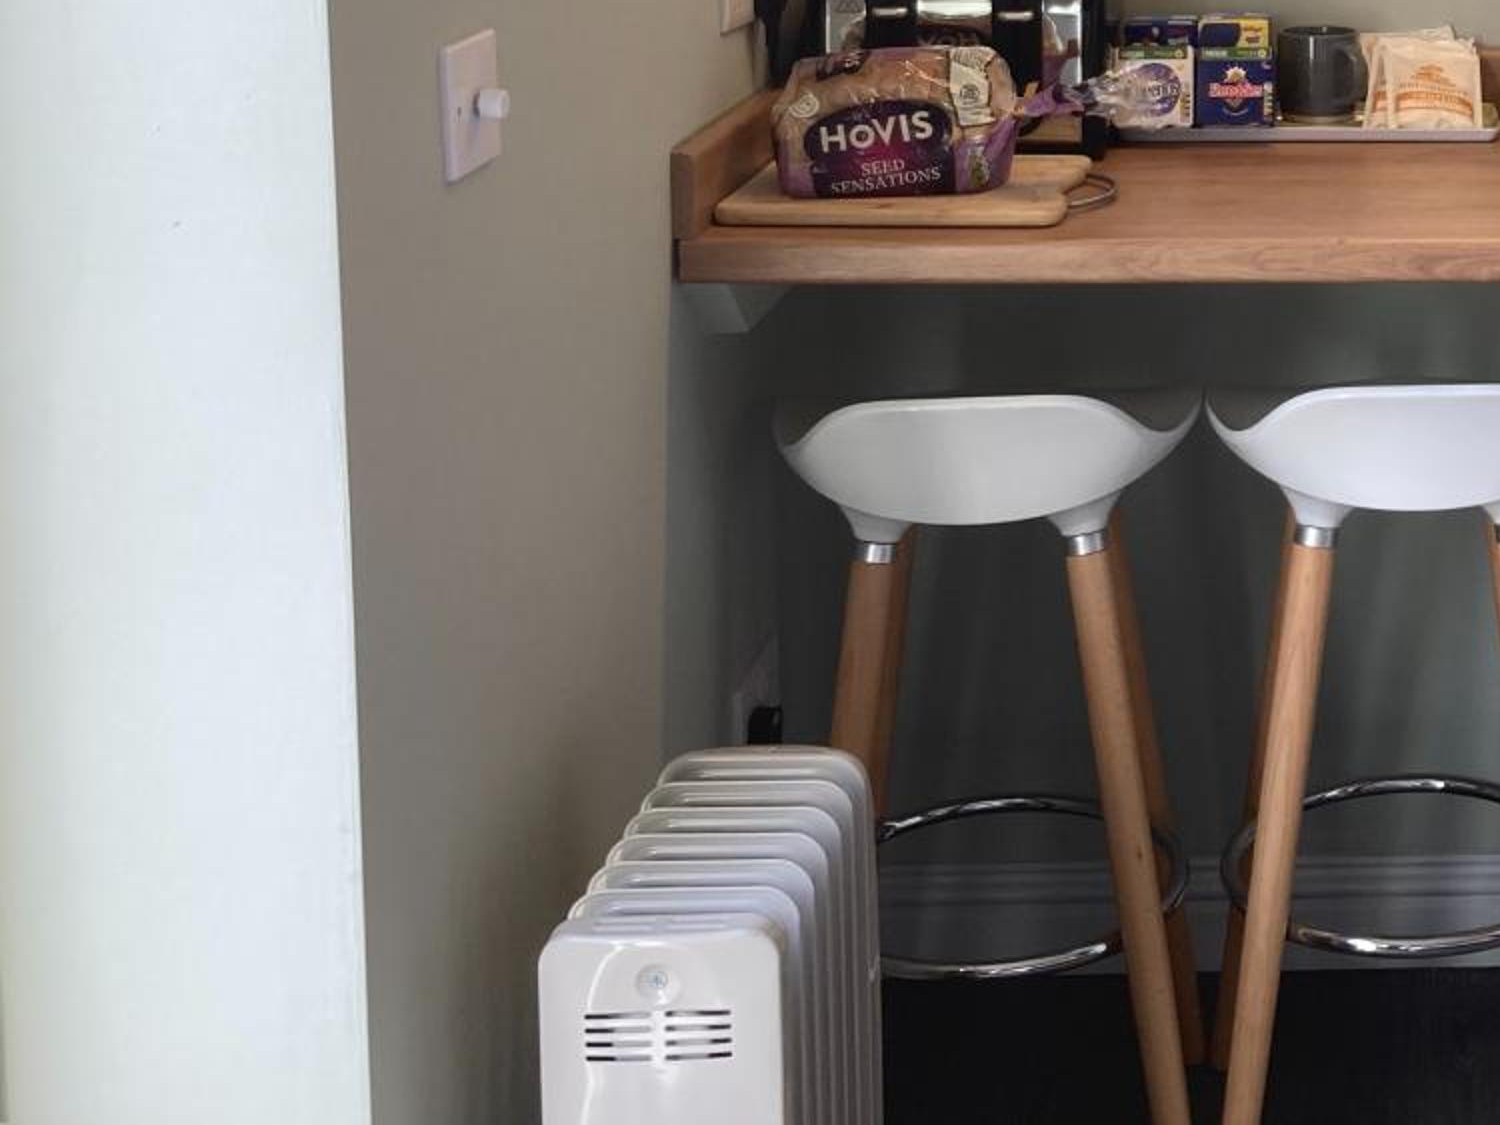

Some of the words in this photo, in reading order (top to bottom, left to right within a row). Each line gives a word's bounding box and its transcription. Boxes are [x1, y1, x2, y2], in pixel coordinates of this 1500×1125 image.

[819, 110, 933, 154] HOVIS
[830, 166, 942, 195] SENSATIONS
[860, 159, 905, 177] SEED
